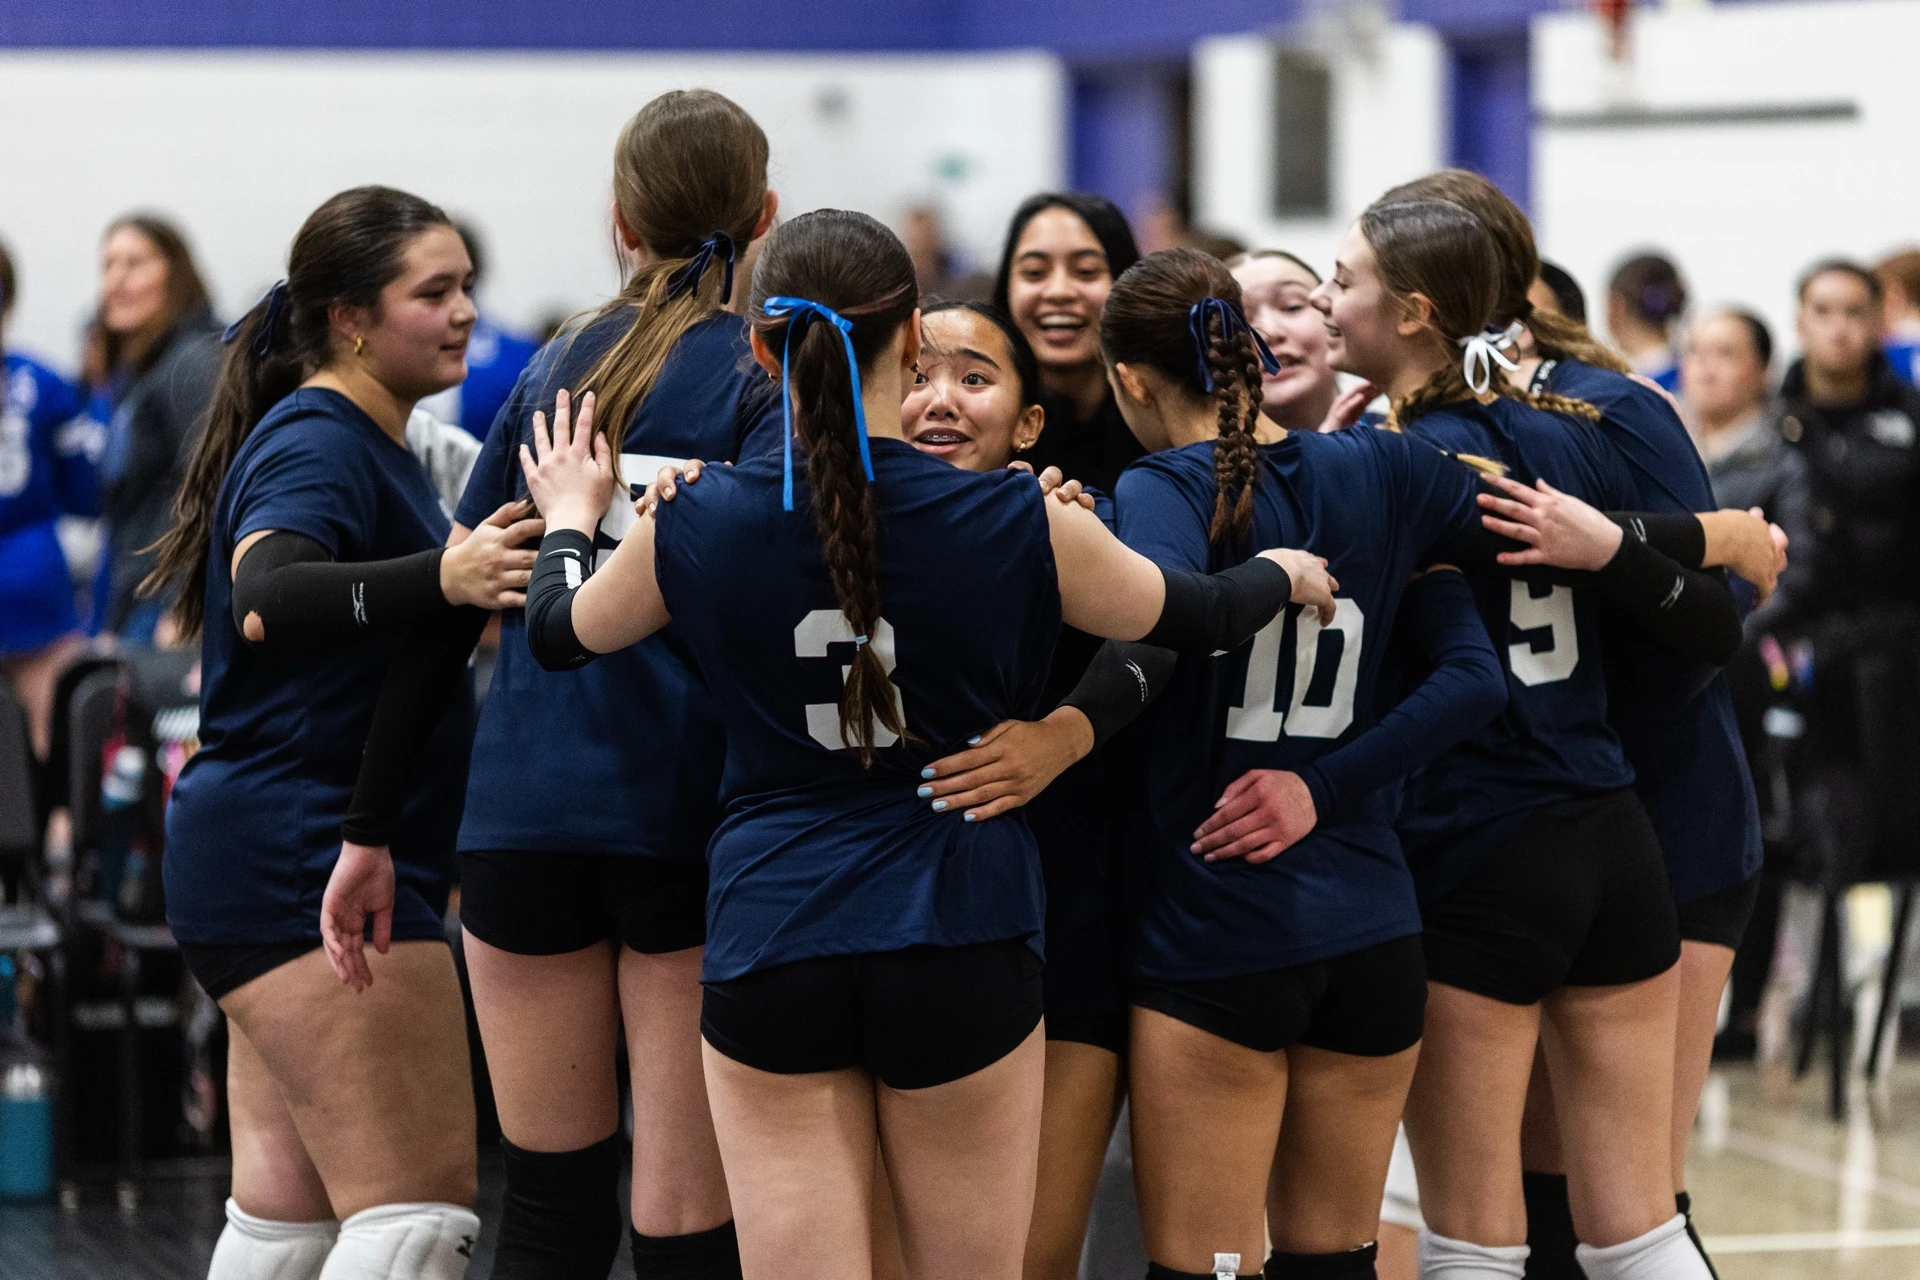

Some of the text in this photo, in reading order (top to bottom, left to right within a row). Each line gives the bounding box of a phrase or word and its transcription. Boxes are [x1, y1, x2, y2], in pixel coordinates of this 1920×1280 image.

[794, 610, 907, 750] 3
[1226, 598, 1365, 742] 10
[1508, 579, 1579, 688] 9
